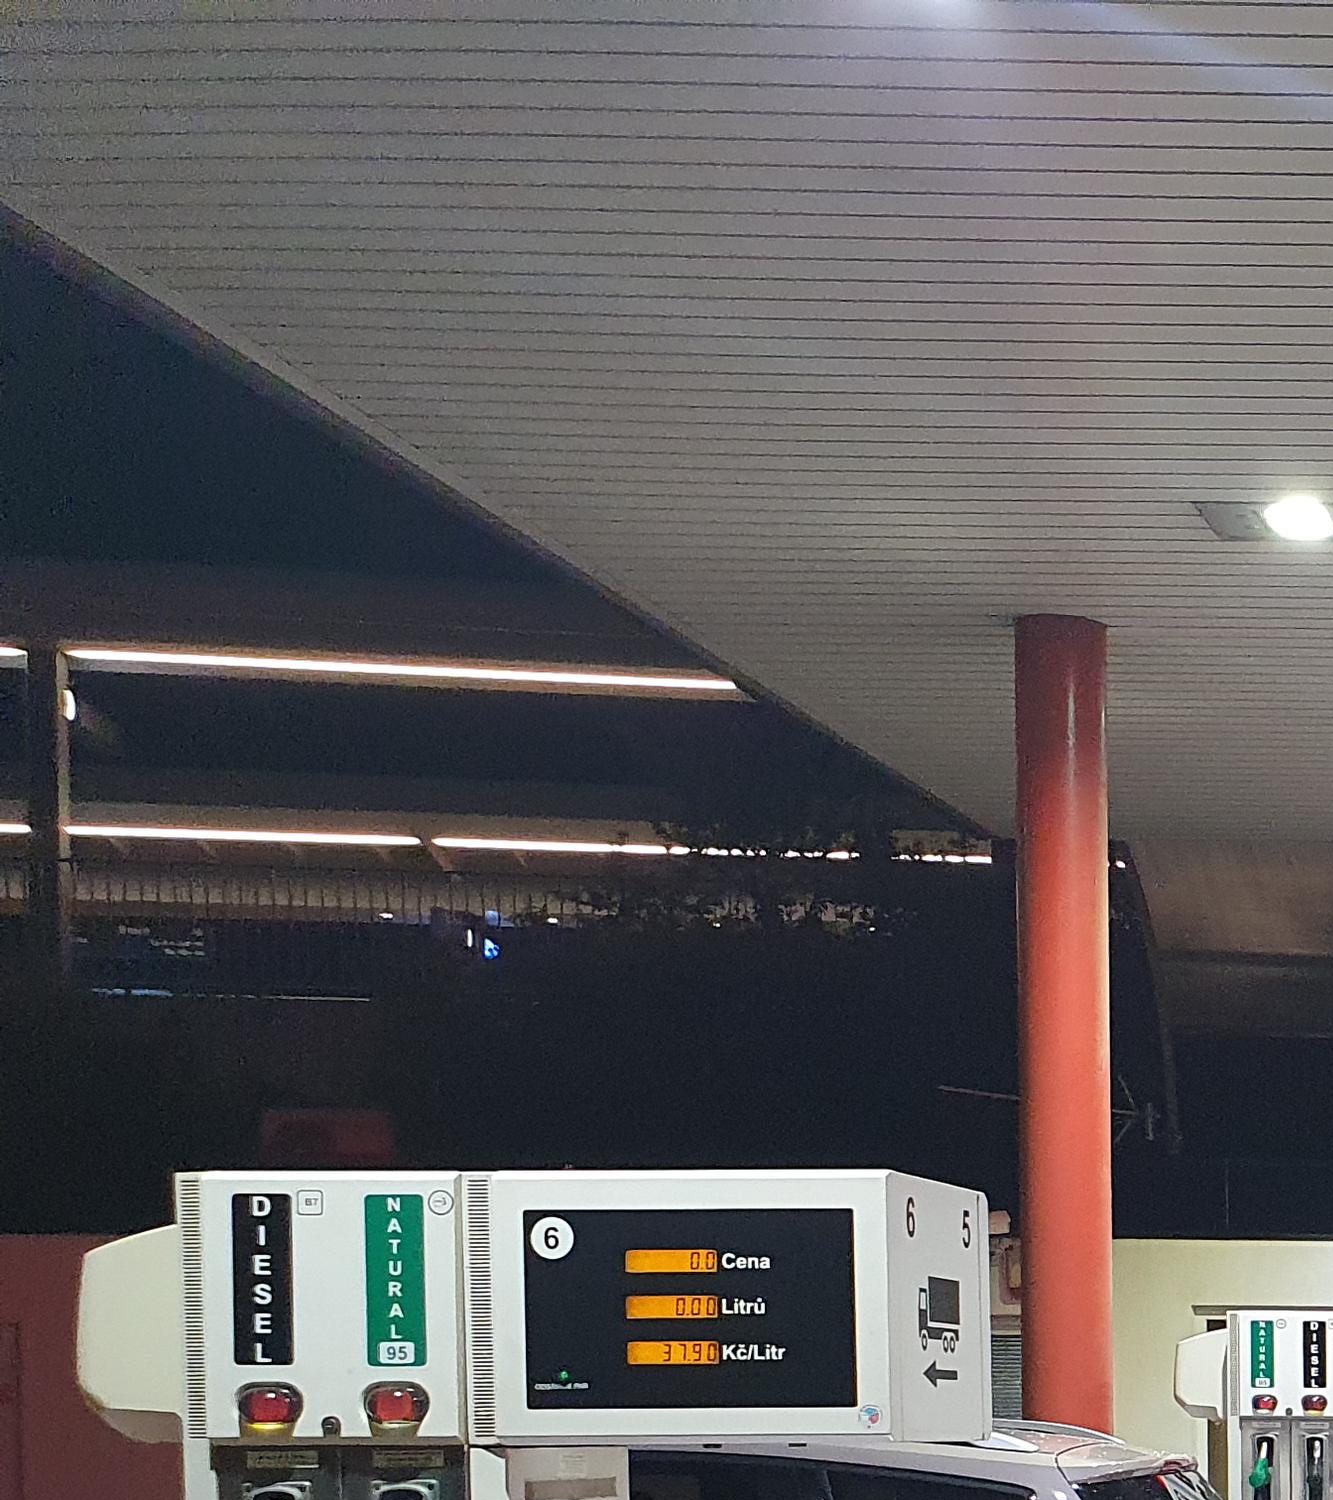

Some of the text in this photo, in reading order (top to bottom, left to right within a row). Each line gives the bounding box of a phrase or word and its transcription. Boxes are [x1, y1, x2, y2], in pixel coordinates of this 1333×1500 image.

[905, 1196, 917, 1239] 6
[961, 1209, 972, 1249] 5
[543, 1226, 561, 1250] 6
[251, 1195, 273, 1364] DIESEL
[387, 1197, 404, 1339] NATURAL
[721, 1253, 771, 1270] Cena
[721, 1297, 767, 1315] Litrů
[386, 1346, 408, 1361] 95
[722, 1345, 786, 1361] Kč/Litr
[1259, 1321, 1267, 1378] NATURAL
[1310, 1321, 1320, 1388] DIESEL
